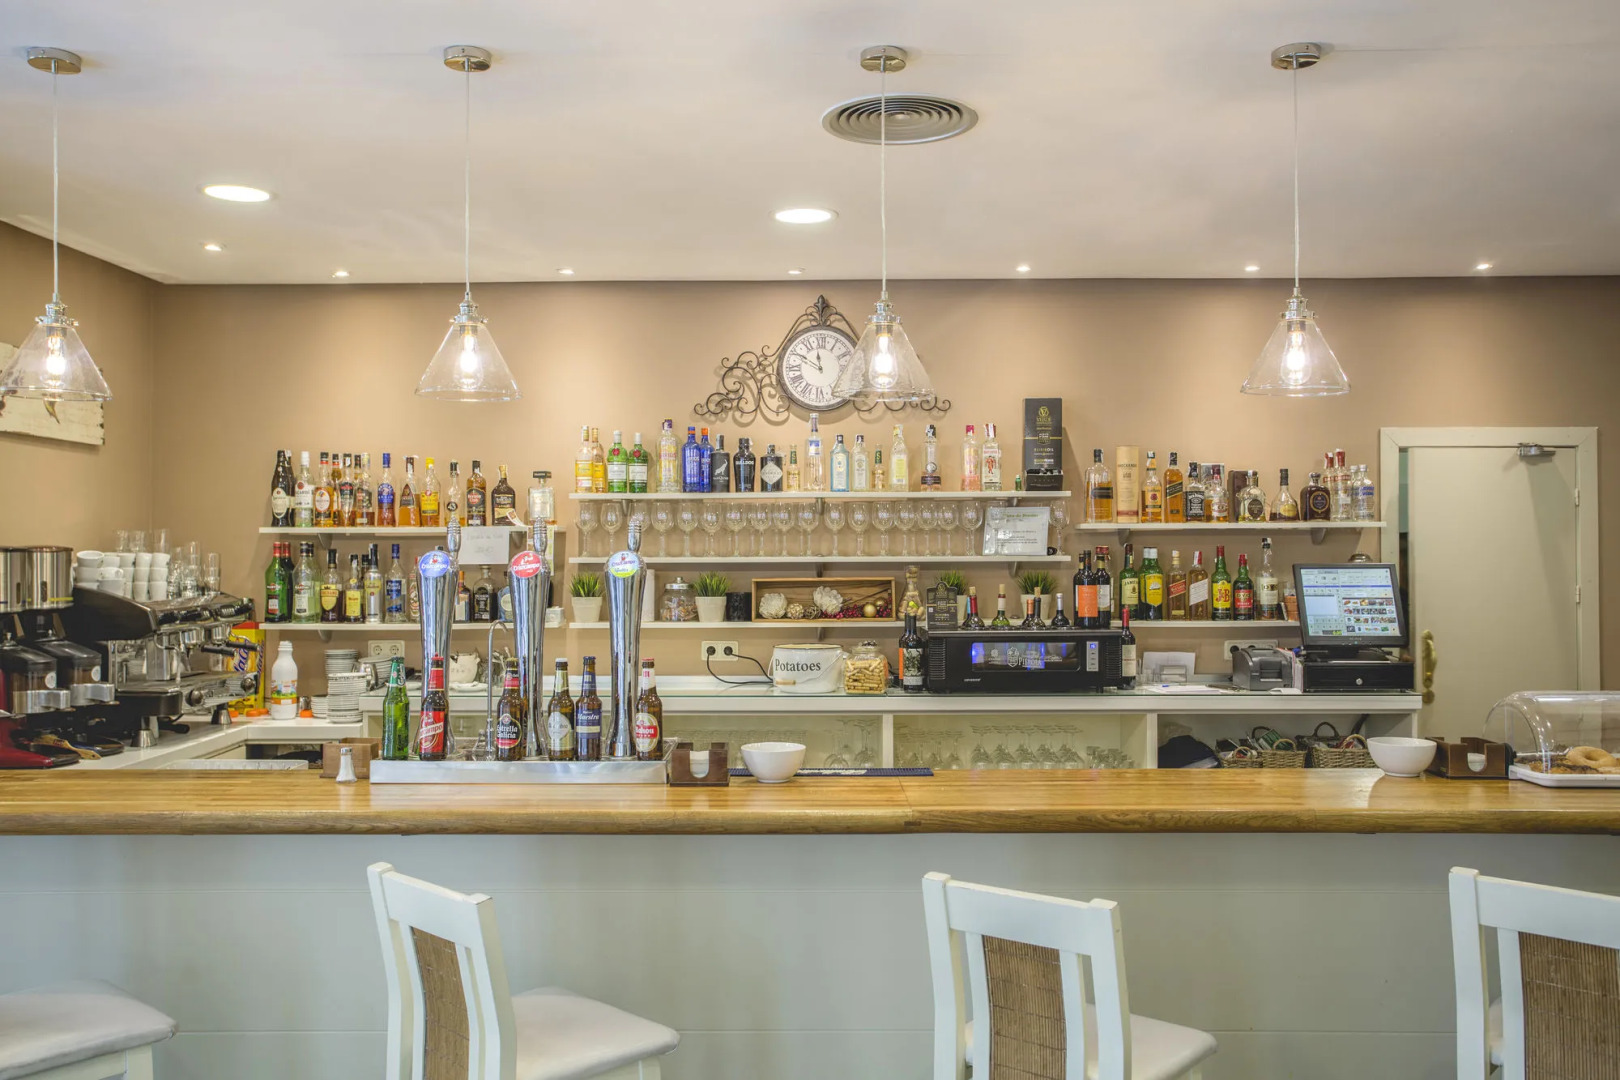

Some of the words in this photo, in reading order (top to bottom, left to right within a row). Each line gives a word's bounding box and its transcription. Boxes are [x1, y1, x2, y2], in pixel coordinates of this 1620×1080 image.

[815, 336, 827, 349] XII
[447, 502, 457, 510] 43
[1216, 588, 1231, 603] J&B
[775, 659, 821, 672] Potatoes
[496, 724, 518, 733] Estrella
